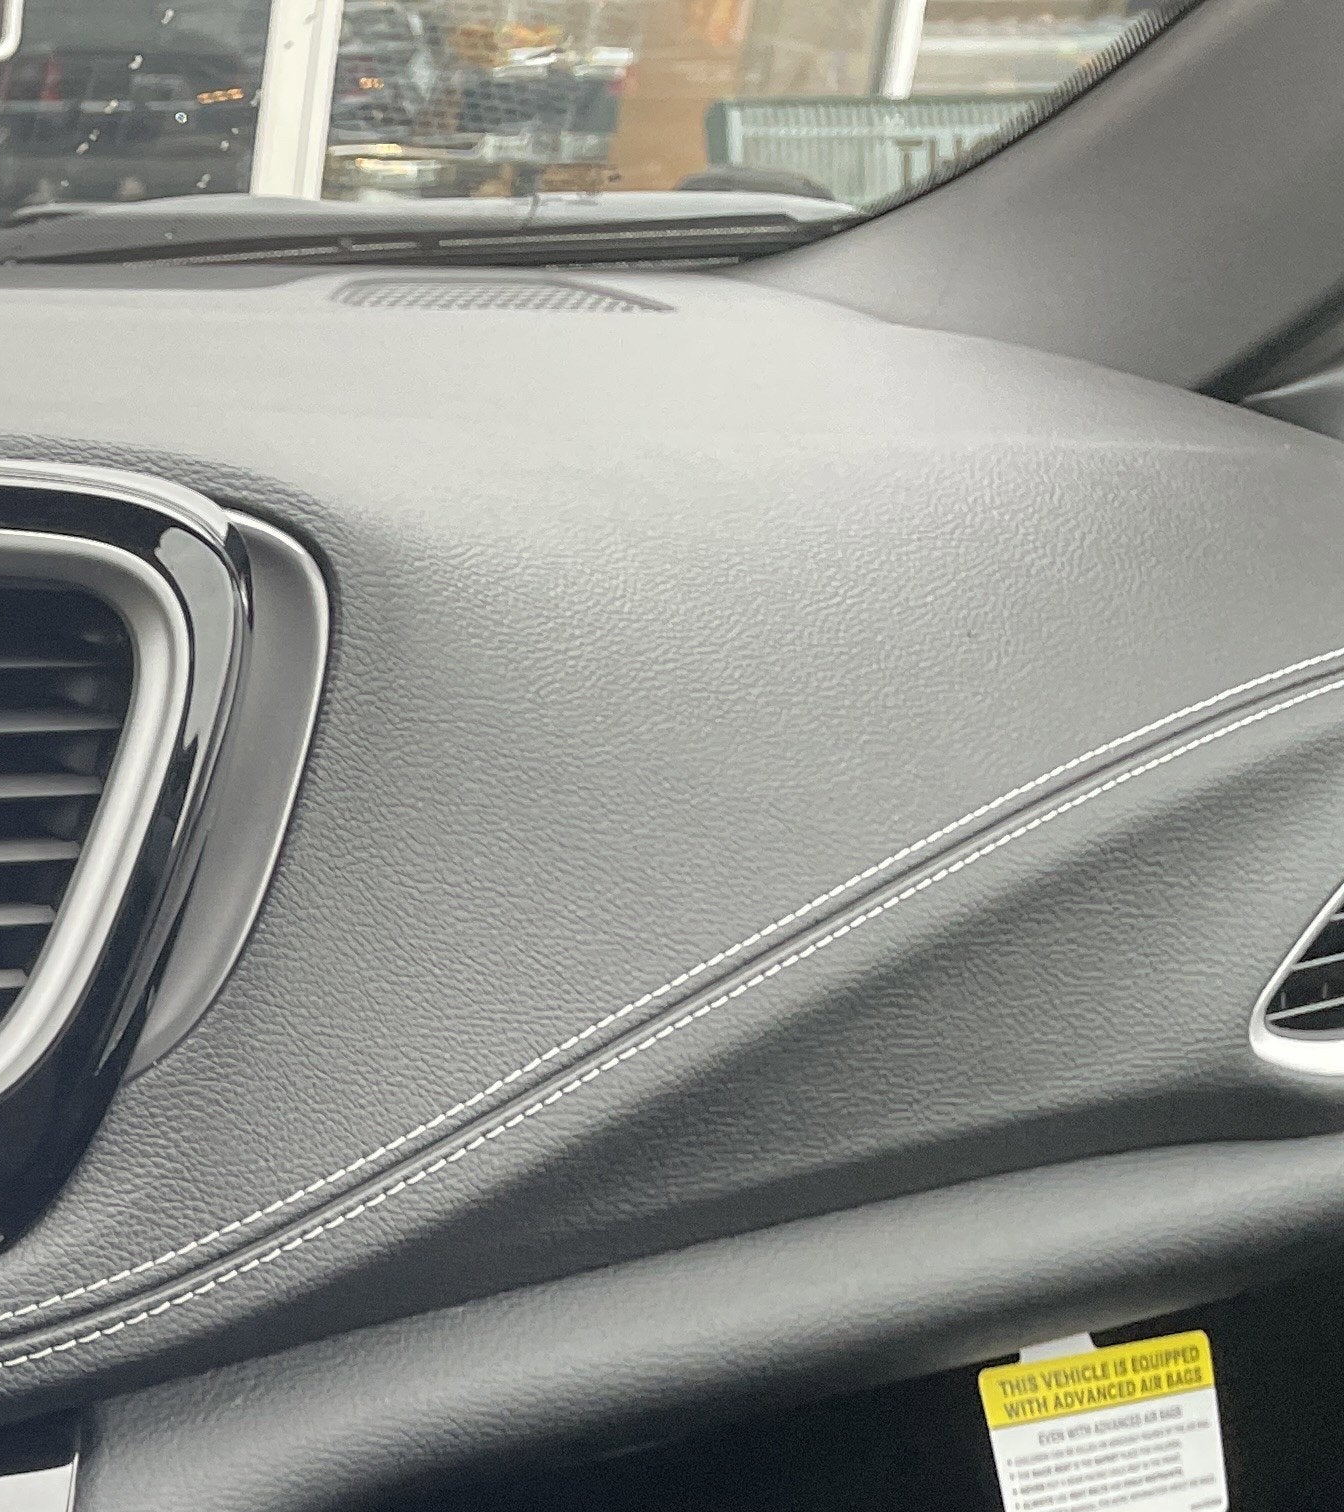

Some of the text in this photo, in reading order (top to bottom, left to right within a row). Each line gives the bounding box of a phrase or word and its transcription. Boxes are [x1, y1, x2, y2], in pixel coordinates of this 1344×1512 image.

[998, 1344, 1201, 1399] THIS VEHICLE IS EQUIPPED
[1002, 1366, 1203, 1421] WITH ADVANCED AIR BAGS
